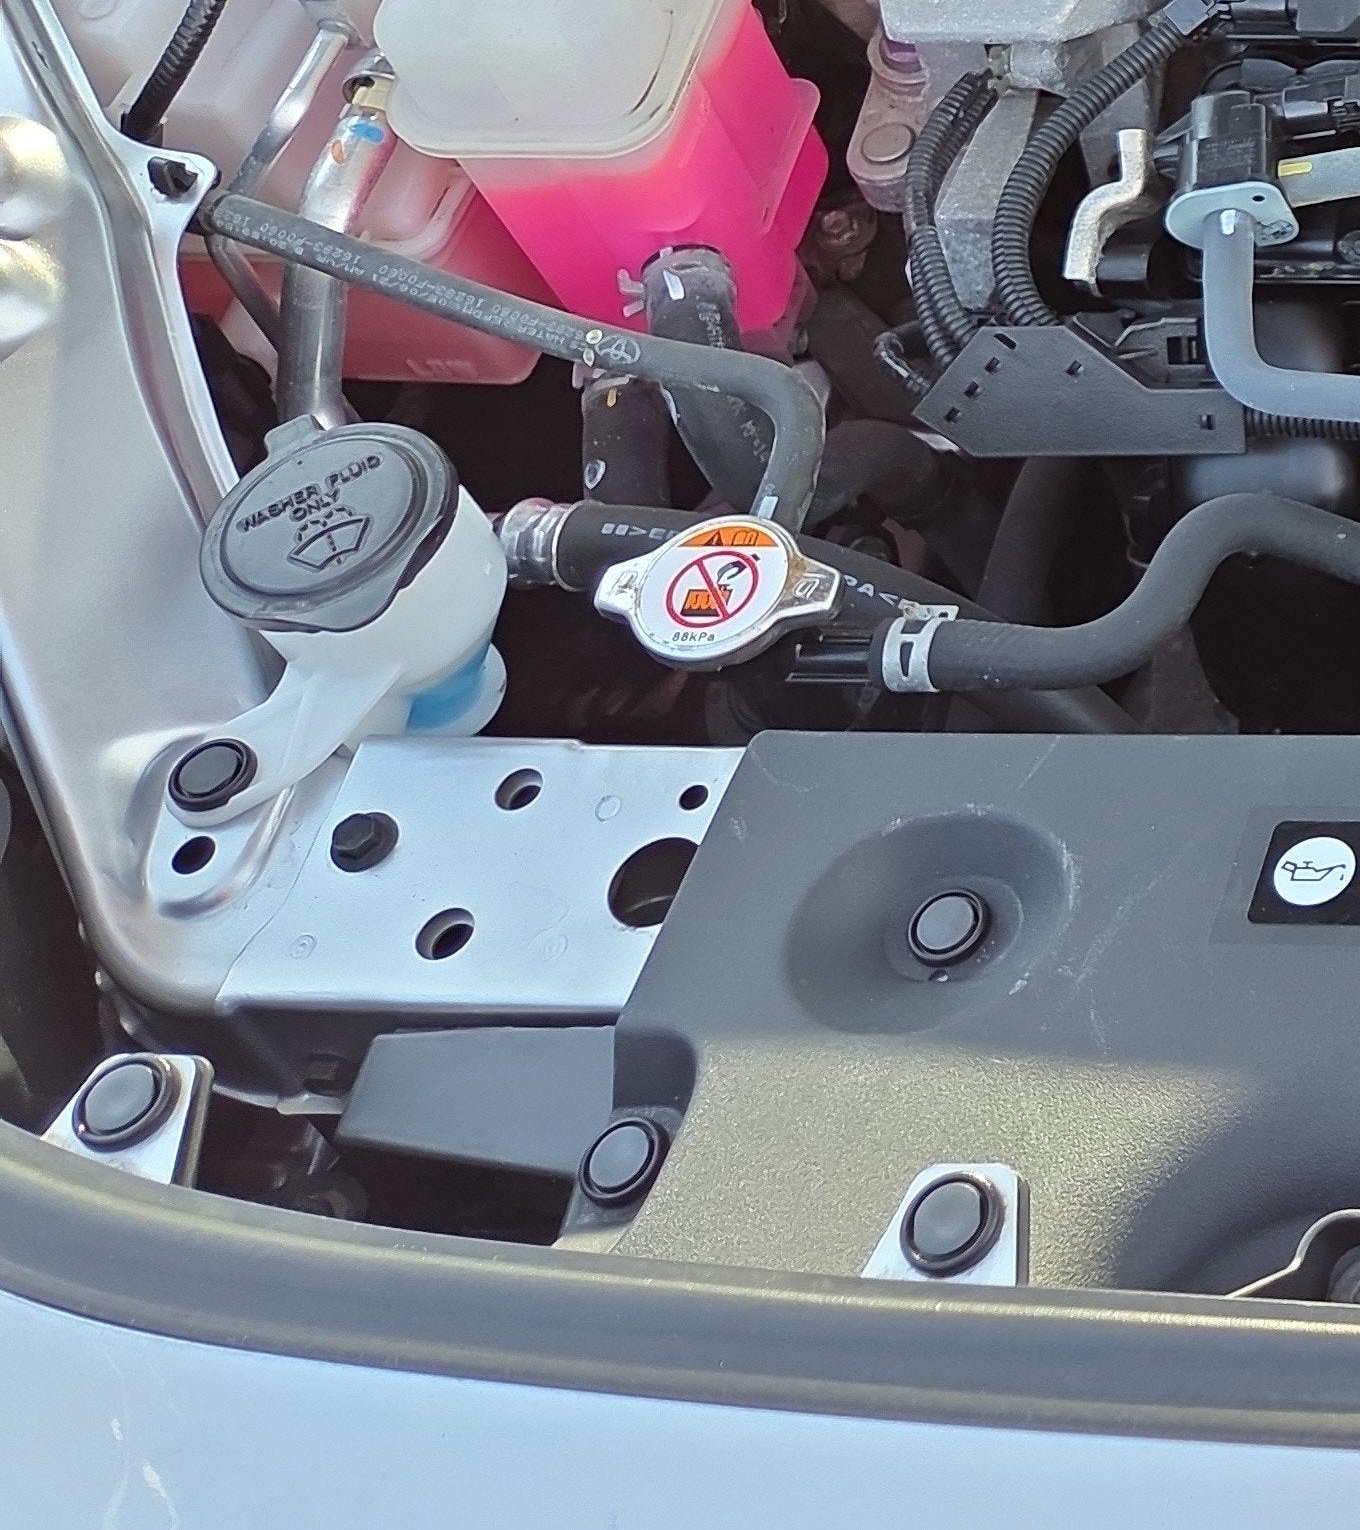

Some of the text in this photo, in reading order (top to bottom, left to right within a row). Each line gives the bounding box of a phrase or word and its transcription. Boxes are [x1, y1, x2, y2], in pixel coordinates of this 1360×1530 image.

[241, 483, 320, 532] WASHER
[290, 488, 341, 522] ONLY
[672, 631, 715, 642] 88kPa
